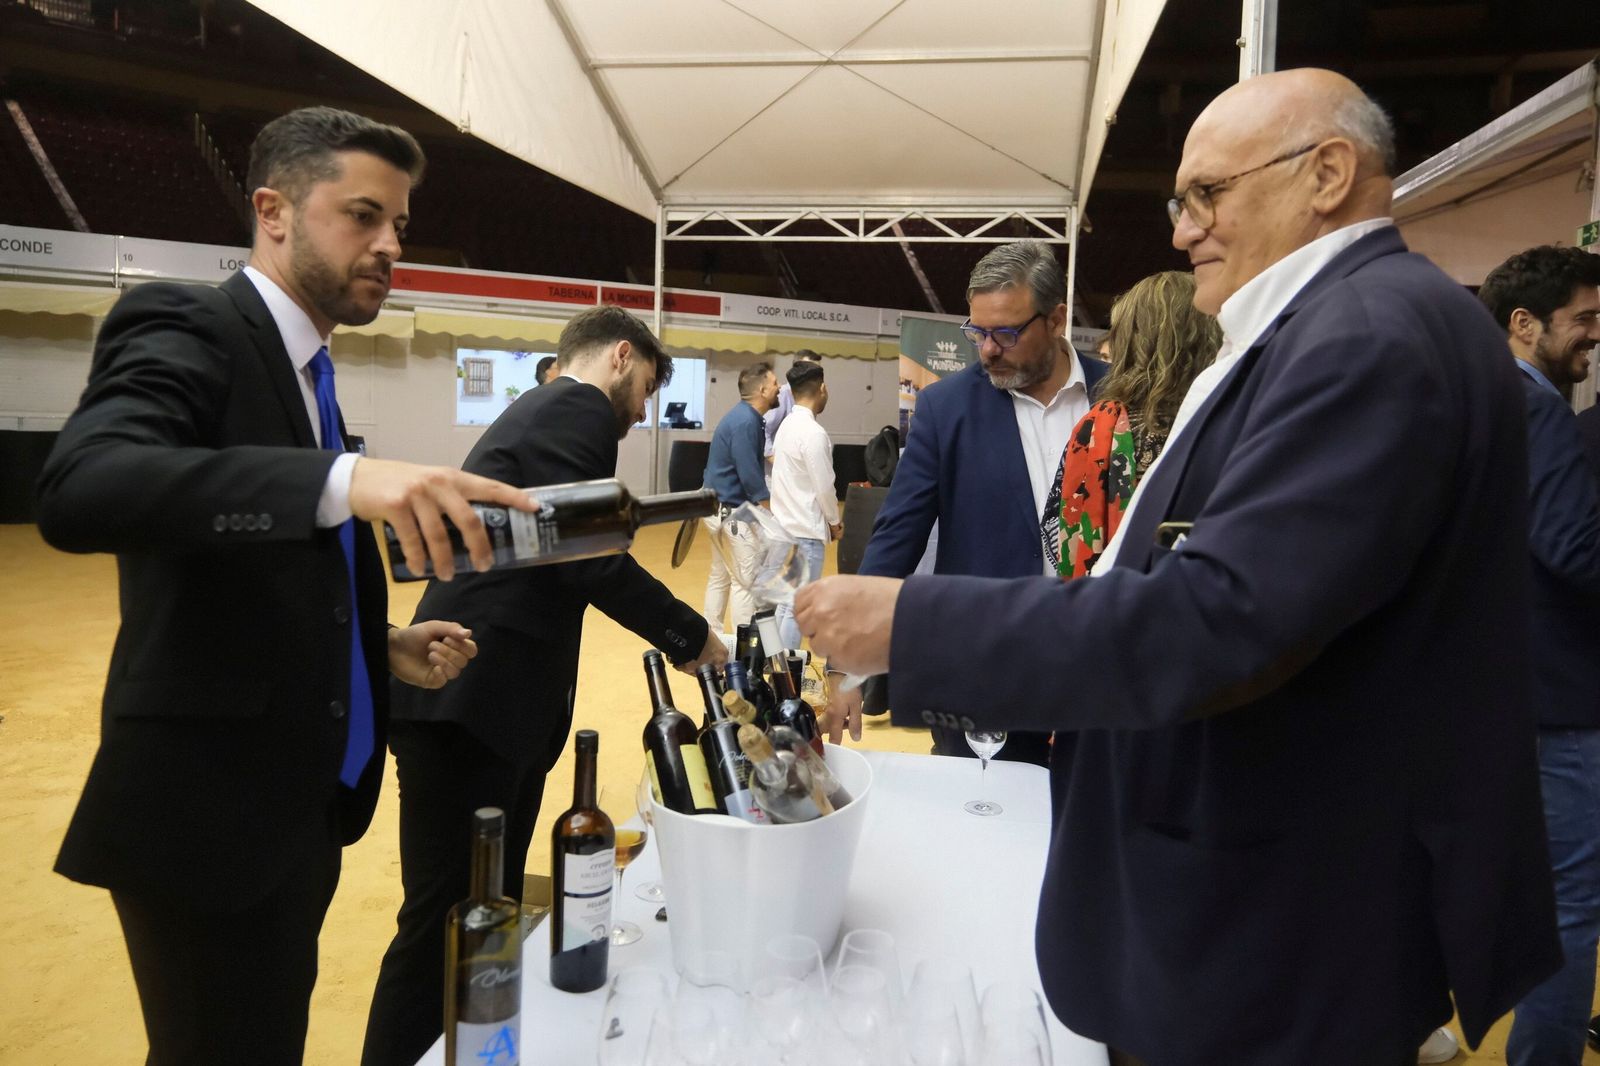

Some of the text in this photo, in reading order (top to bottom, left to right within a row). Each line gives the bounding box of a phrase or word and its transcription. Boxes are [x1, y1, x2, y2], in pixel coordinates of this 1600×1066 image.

[0, 238, 53, 255] CONDE
[123, 253, 133, 262] 10
[219, 258, 246, 271] LOS
[547, 286, 595, 300] TABERNA
[756, 305, 781, 316] COOP.
[801, 310, 828, 321] LOCAL
